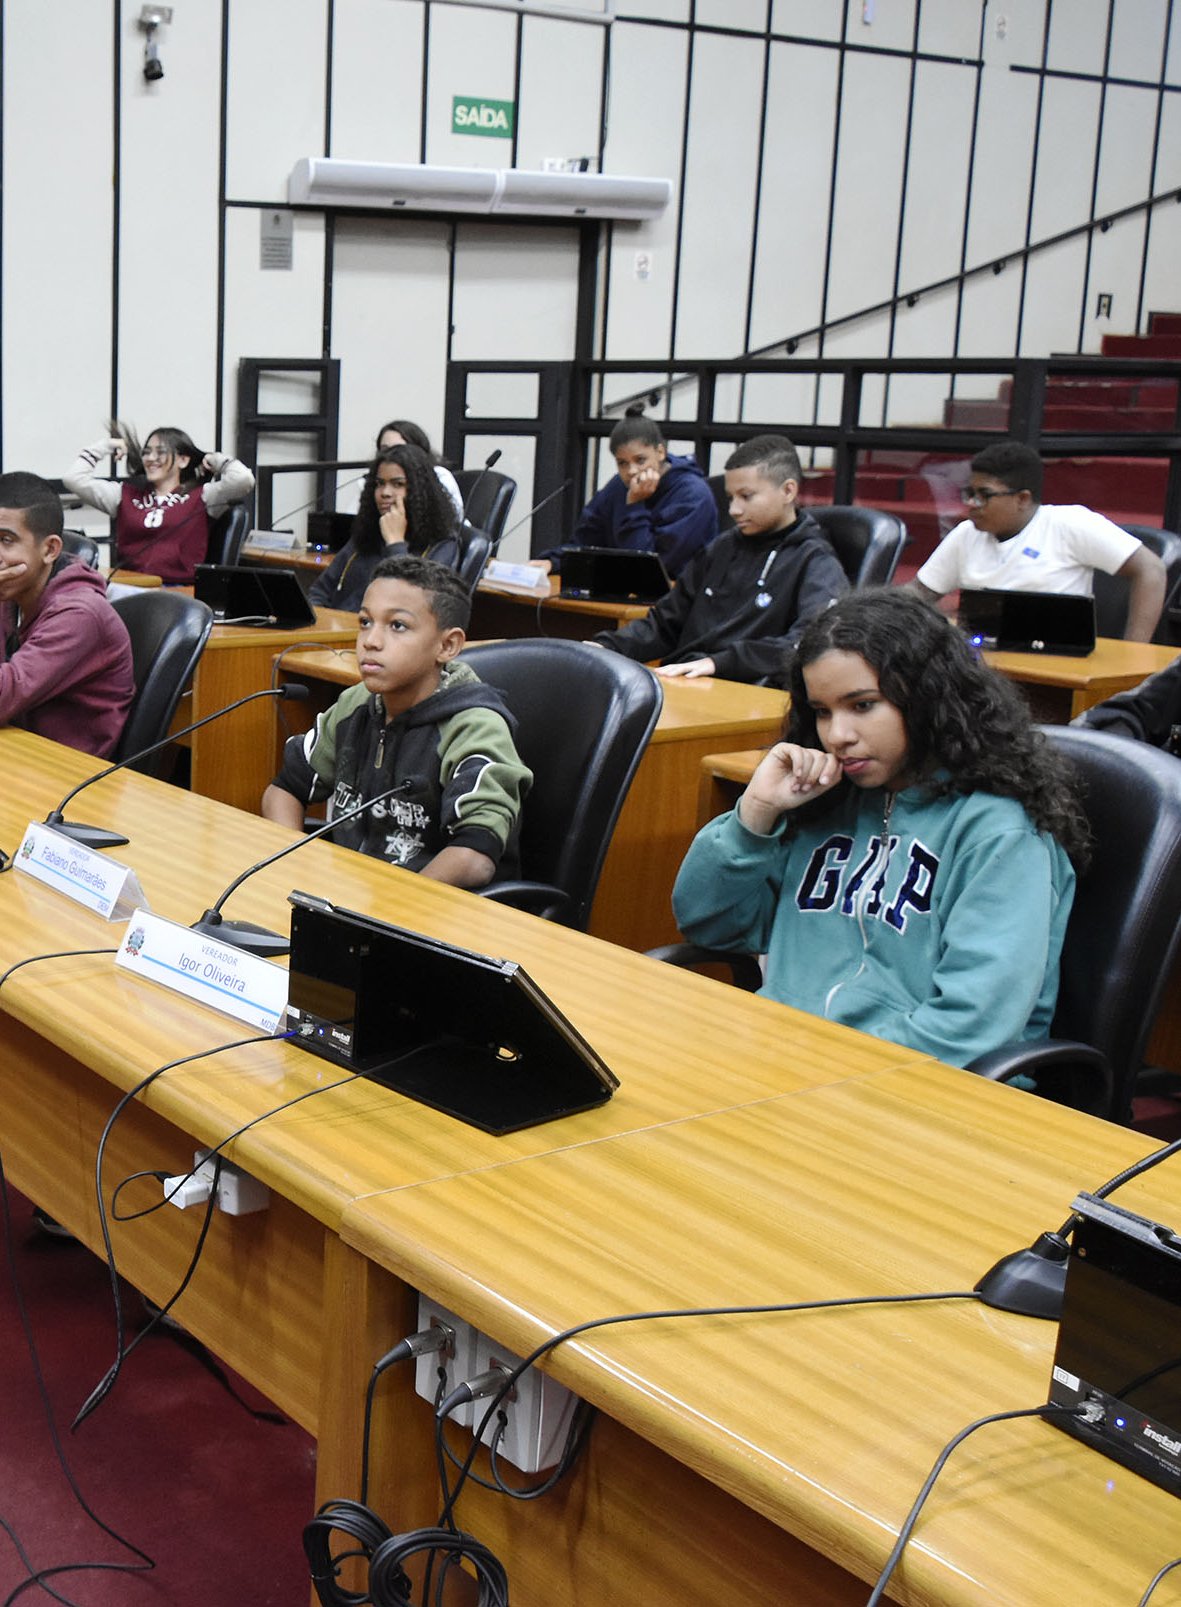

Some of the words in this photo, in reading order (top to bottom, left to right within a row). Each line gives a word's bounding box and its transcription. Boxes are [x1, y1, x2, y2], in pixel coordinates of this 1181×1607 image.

[455, 104, 509, 130] SAÍDA
[42, 846, 68, 870] Fabiano
[69, 861, 107, 891] Guimarães
[795, 833, 940, 936] GAP
[201, 945, 239, 967] VEREADOR
[178, 953, 201, 972] Igor
[203, 963, 246, 993] Oliveira
[260, 1018, 276, 1031] MDB
